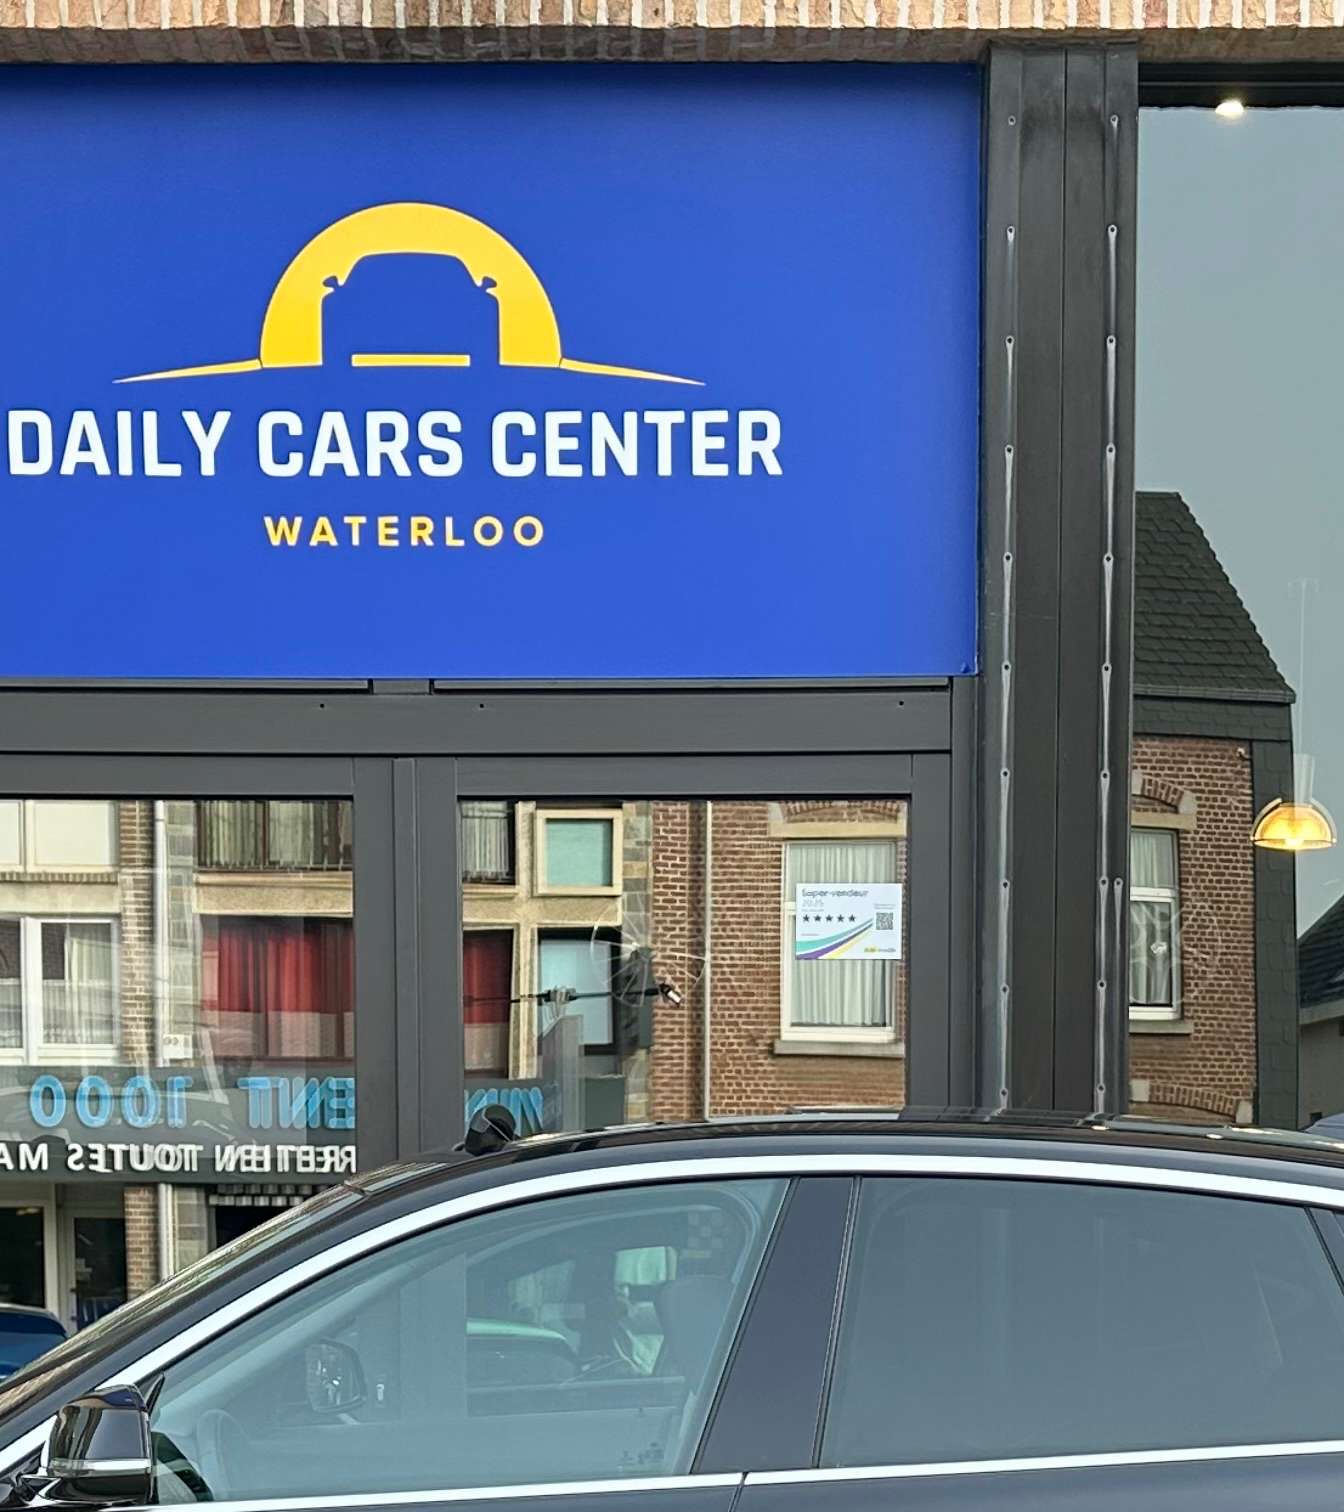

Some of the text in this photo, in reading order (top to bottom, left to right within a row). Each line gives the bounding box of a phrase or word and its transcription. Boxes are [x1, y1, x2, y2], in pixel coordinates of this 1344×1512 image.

[7, 409, 783, 477] DAILY CARS CENTER
[264, 515, 545, 546] WATERLOO
